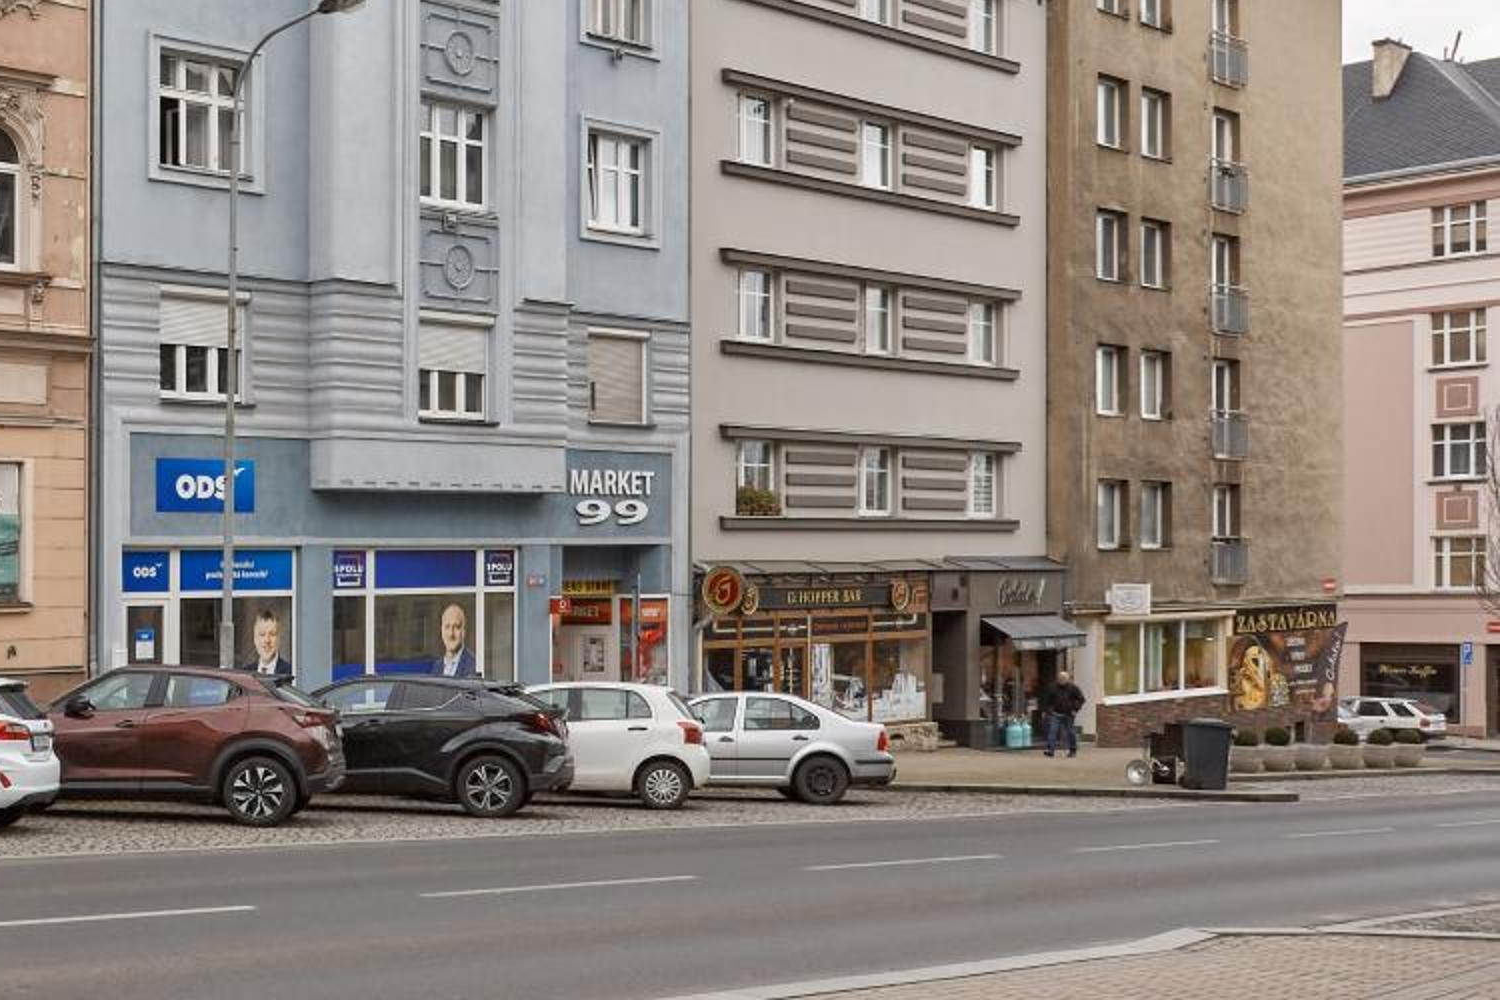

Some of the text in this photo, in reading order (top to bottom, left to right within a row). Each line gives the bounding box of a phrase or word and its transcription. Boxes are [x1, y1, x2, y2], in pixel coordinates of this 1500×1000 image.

[175, 474, 226, 500] ODS
[570, 469, 655, 495] MARKET
[575, 499, 649, 526] 99
[133, 566, 157, 578] ODS
